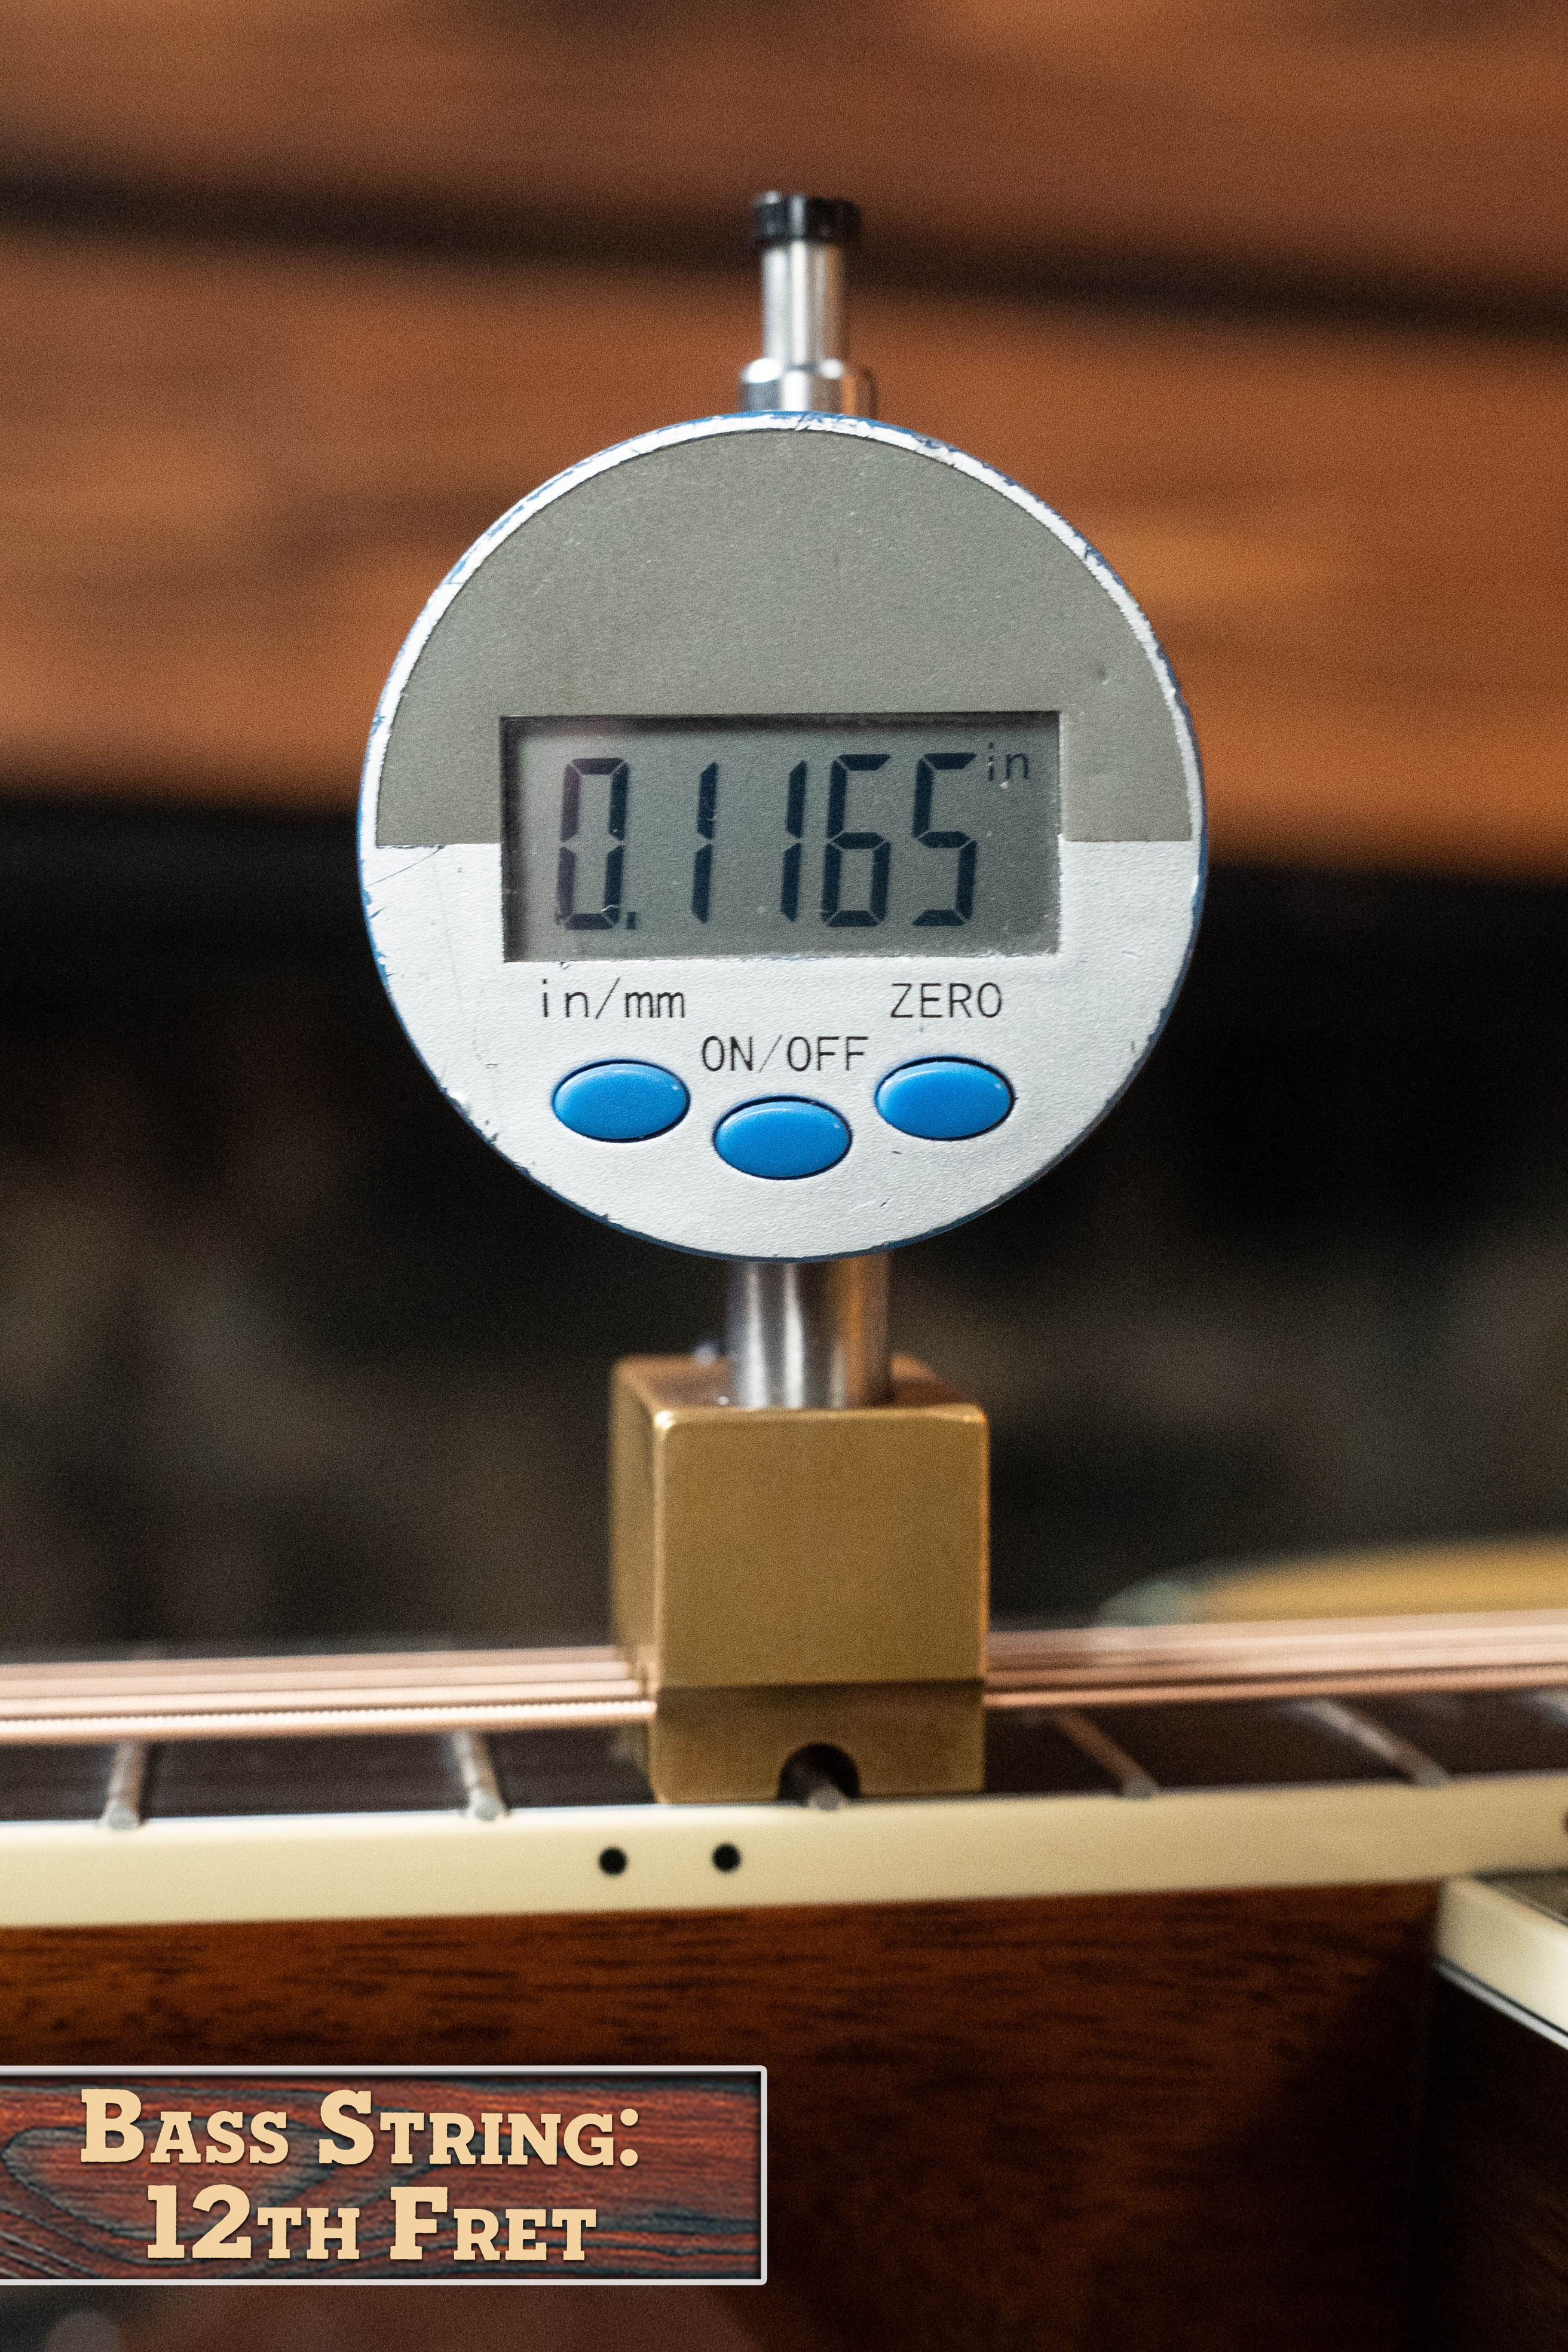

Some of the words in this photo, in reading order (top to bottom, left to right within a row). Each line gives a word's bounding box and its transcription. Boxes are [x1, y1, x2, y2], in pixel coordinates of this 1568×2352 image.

[556, 752, 978, 930] 0.1165
[985, 742, 1031, 782] in
[541, 976, 686, 1020] in/mm
[889, 982, 1003, 1019] ZERO
[700, 1034, 869, 1074] ON/OFF
